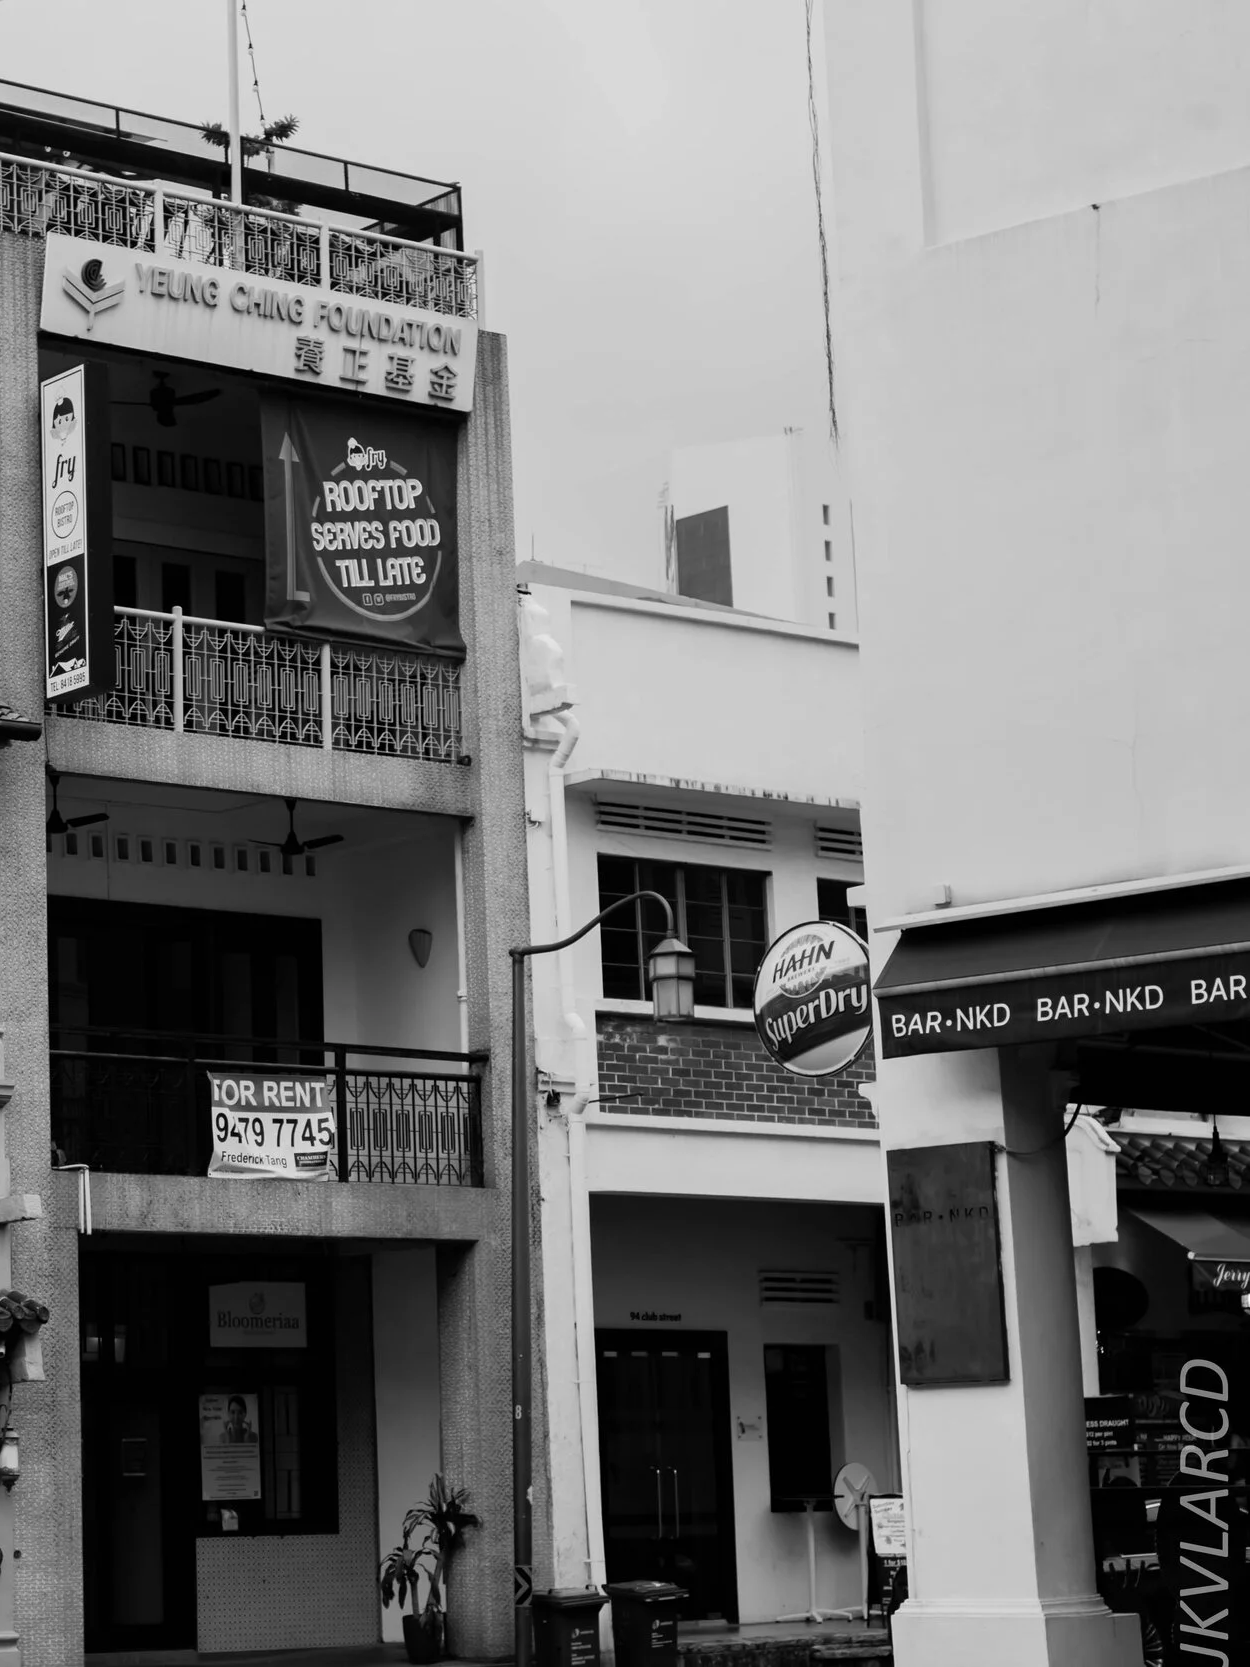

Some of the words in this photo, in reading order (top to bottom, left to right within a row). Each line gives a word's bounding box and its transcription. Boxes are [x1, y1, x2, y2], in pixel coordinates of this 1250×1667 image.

[135, 263, 220, 307] YEUNG
[230, 282, 305, 324] CHING
[313, 300, 462, 356] FOUNDATION
[52, 454, 76, 489] fry
[366, 446, 388, 471] fry
[54, 500, 74, 516] ROOFTOP
[323, 479, 423, 512] ROOFTOP
[57, 513, 73, 528] BISTRO
[311, 520, 385, 551] SERVES
[388, 518, 441, 549] FOOD
[335, 558, 375, 587] TILL
[376, 556, 427, 586] LATE
[772, 940, 835, 983] HAHN
[1190, 975, 1248, 1004] BAR
[766, 984, 868, 1051] SuperDry
[263, 1081, 325, 1107] RENT
[216, 1112, 265, 1147] 9479
[272, 1117, 332, 1147] 7745
[221, 1151, 264, 1165] Frederick
[265, 1154, 287, 1168] Tang
[217, 1310, 299, 1330] Bloomeriaa
[630, 1311, 640, 1321] 94
[641, 1311, 658, 1321] club
[659, 1313, 681, 1322] street
[515, 1404, 522, 1420] 8
[1099, 1419, 1129, 1428] DRAUGHT
